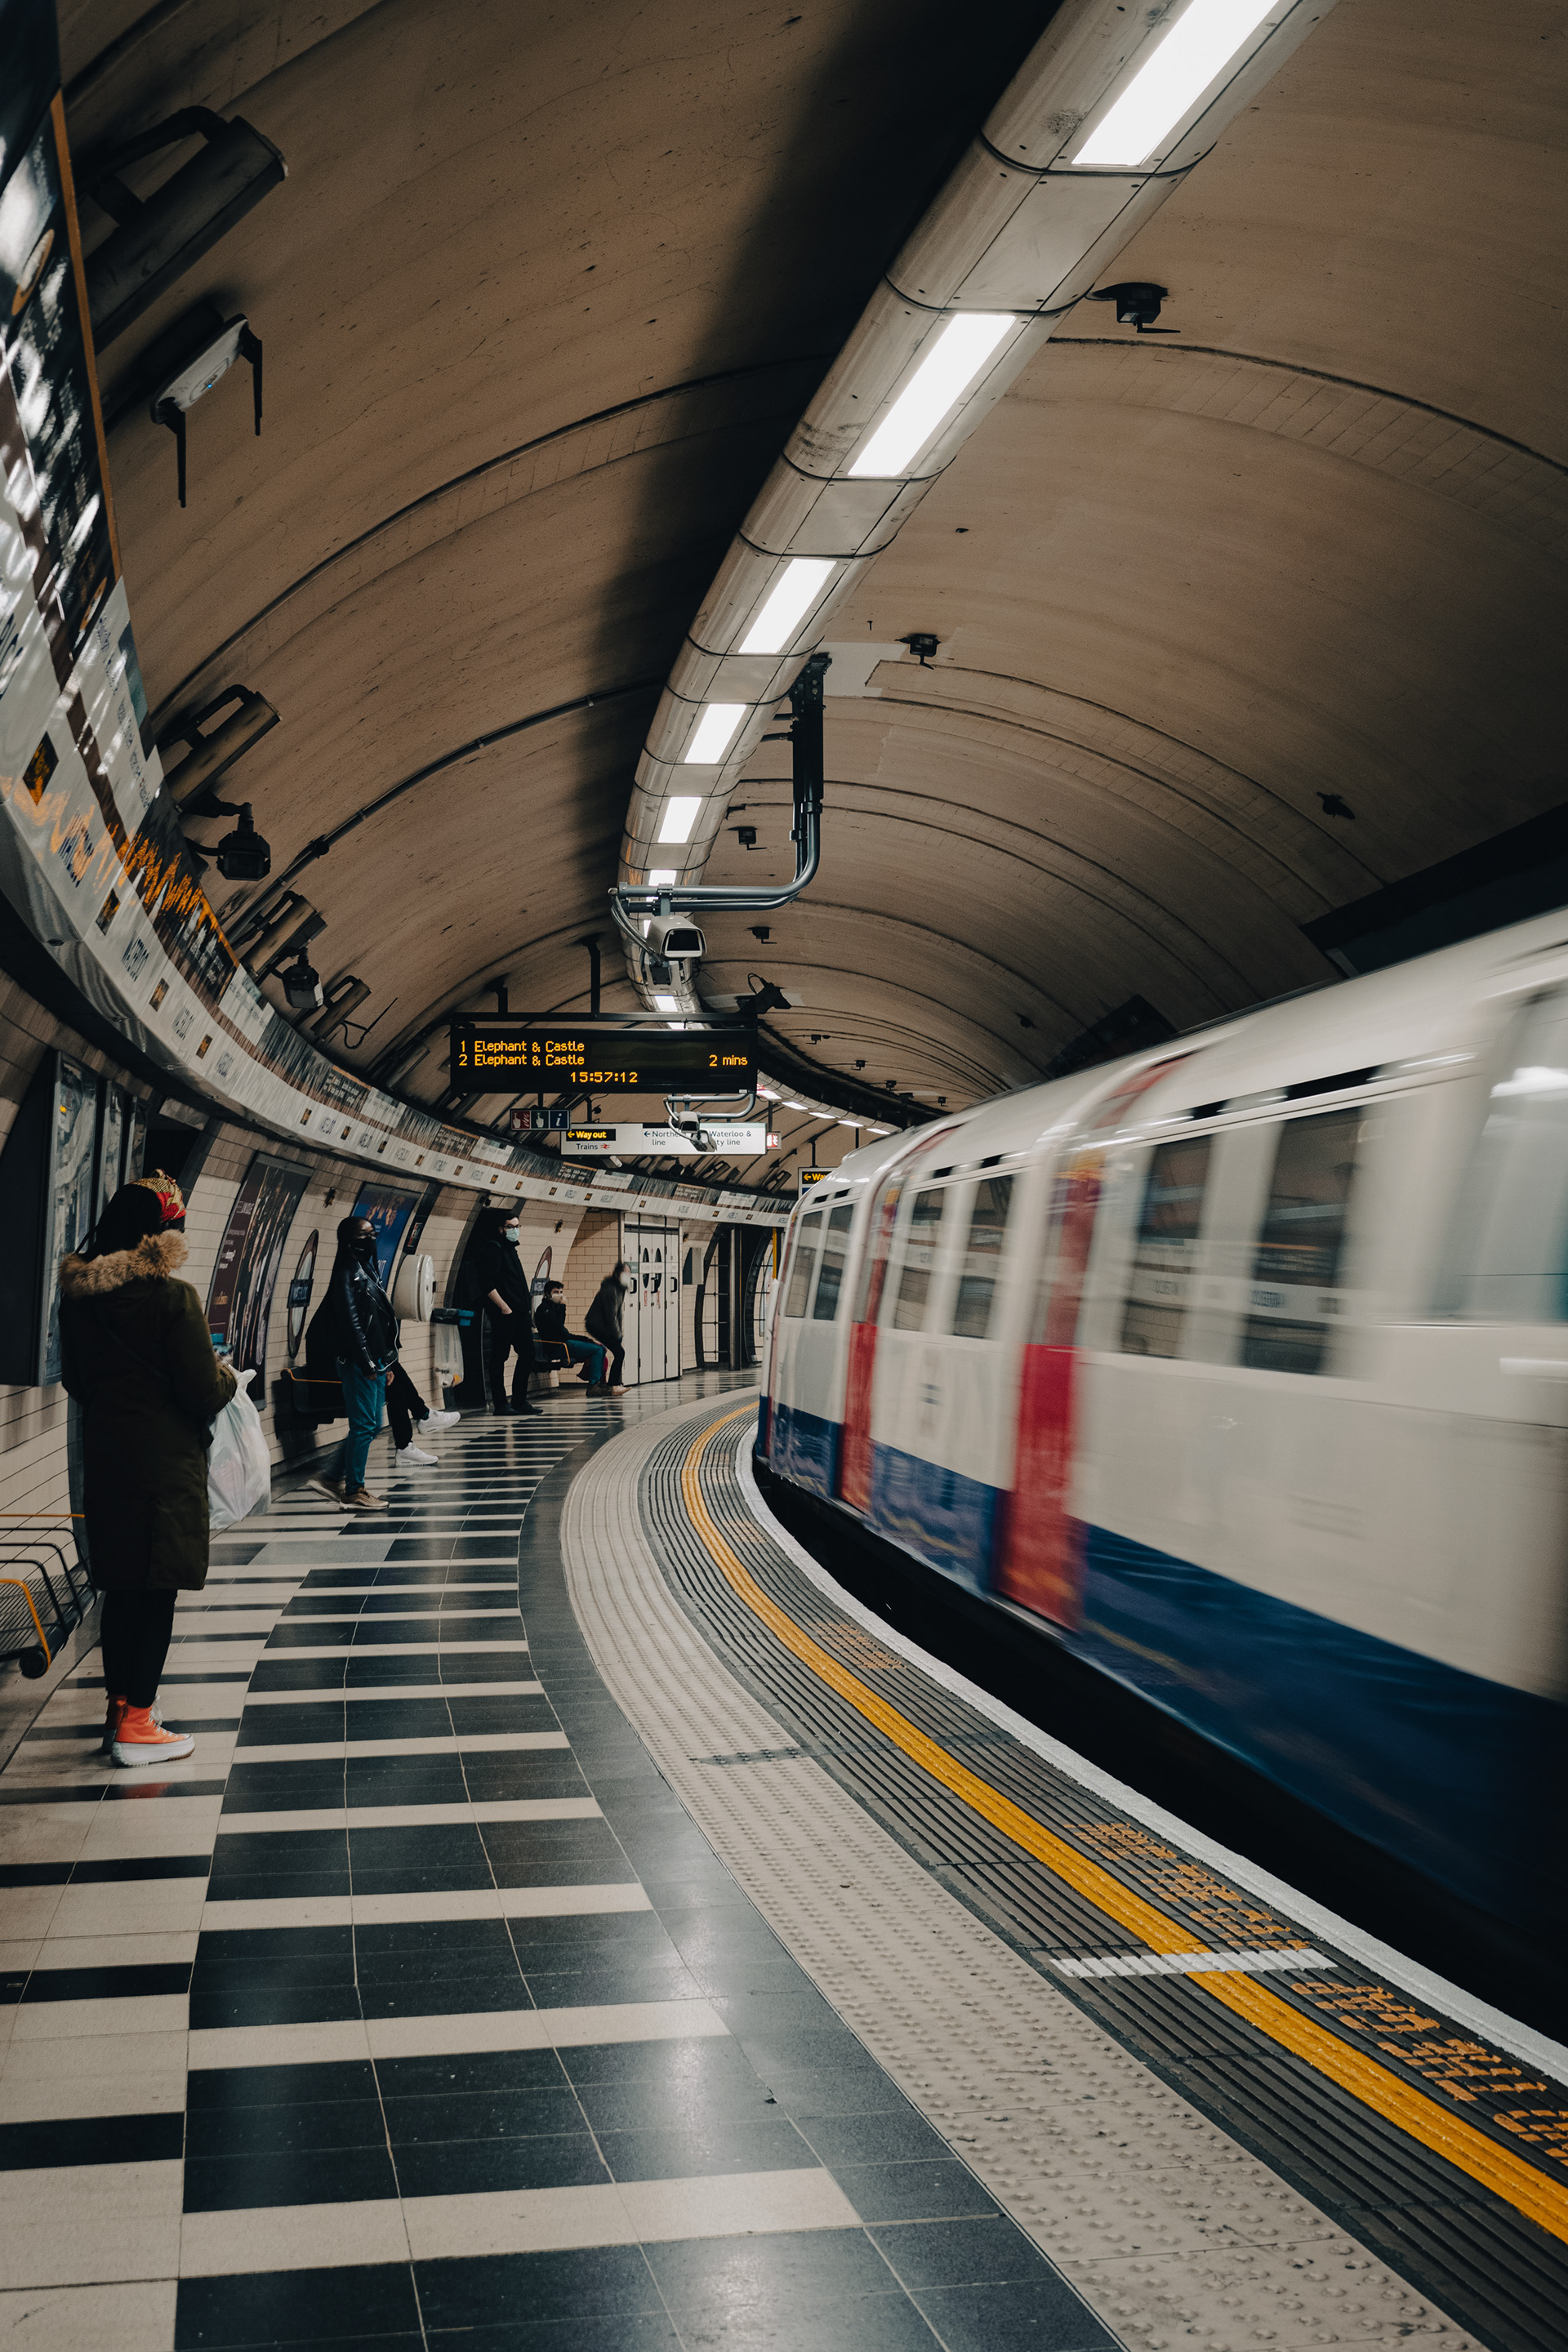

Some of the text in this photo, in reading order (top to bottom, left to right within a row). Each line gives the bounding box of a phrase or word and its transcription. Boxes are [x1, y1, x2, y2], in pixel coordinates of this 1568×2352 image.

[461, 1040, 585, 1054] 1 Elephant & Castle
[459, 1054, 748, 1067] 2 Elephant & Castle 2 mins
[570, 1071, 638, 1083] 15:57:12
[576, 1131, 592, 1140] Way
